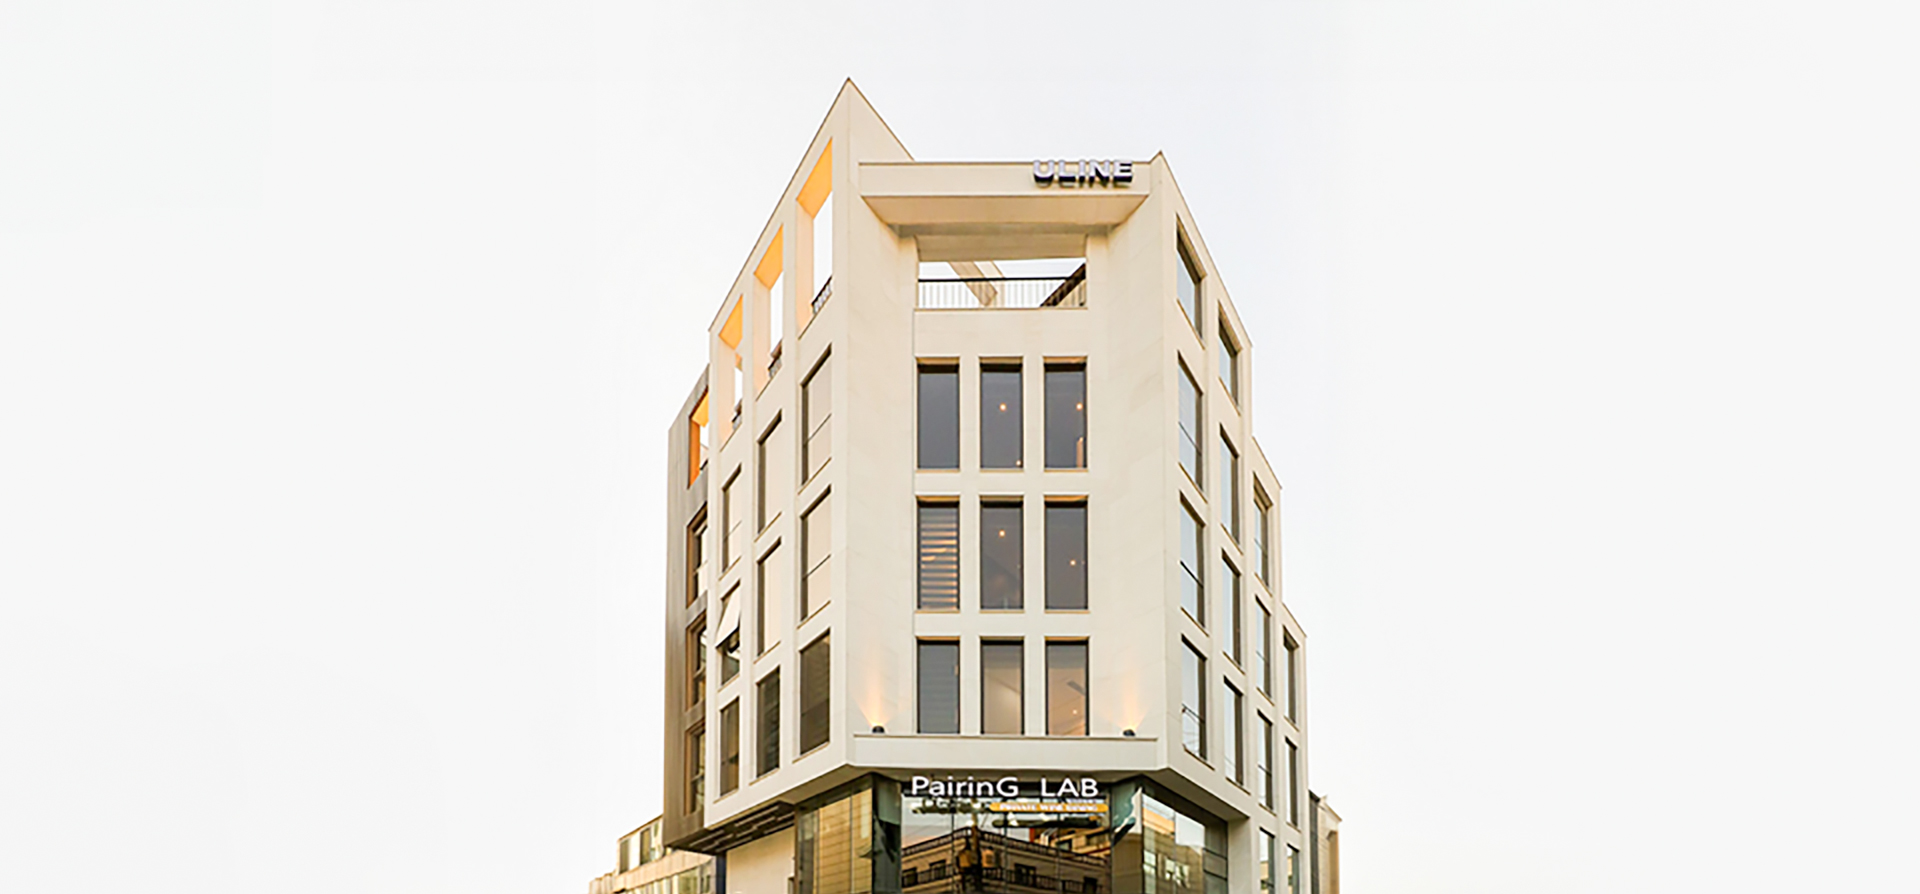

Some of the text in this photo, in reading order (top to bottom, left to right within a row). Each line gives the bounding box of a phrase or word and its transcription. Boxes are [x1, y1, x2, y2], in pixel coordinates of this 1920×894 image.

[1033, 159, 1133, 183] ULINE
[911, 775, 1099, 797] PairinG LAB
